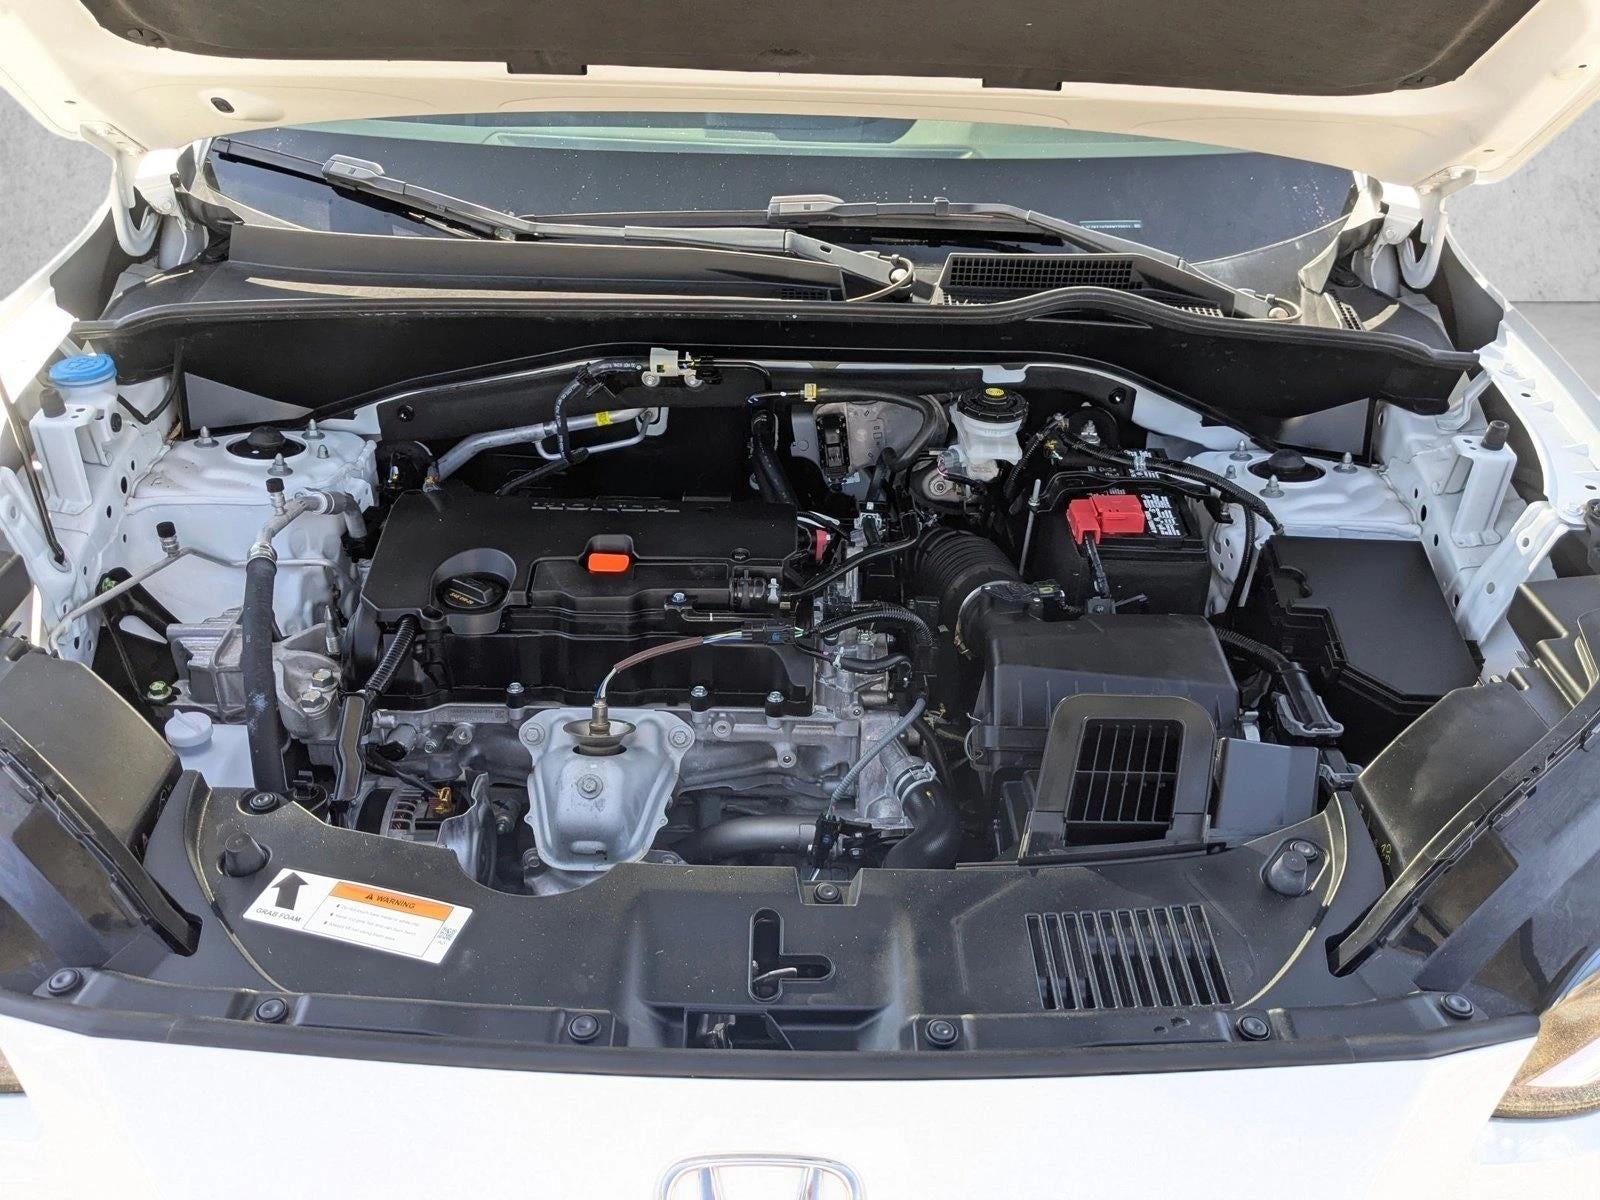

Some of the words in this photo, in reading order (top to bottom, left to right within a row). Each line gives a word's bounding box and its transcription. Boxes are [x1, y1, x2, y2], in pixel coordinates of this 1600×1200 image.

[376, 895, 416, 909] WARNING
[256, 907, 278, 918] GRAB
[278, 912, 302, 922] FOAM
